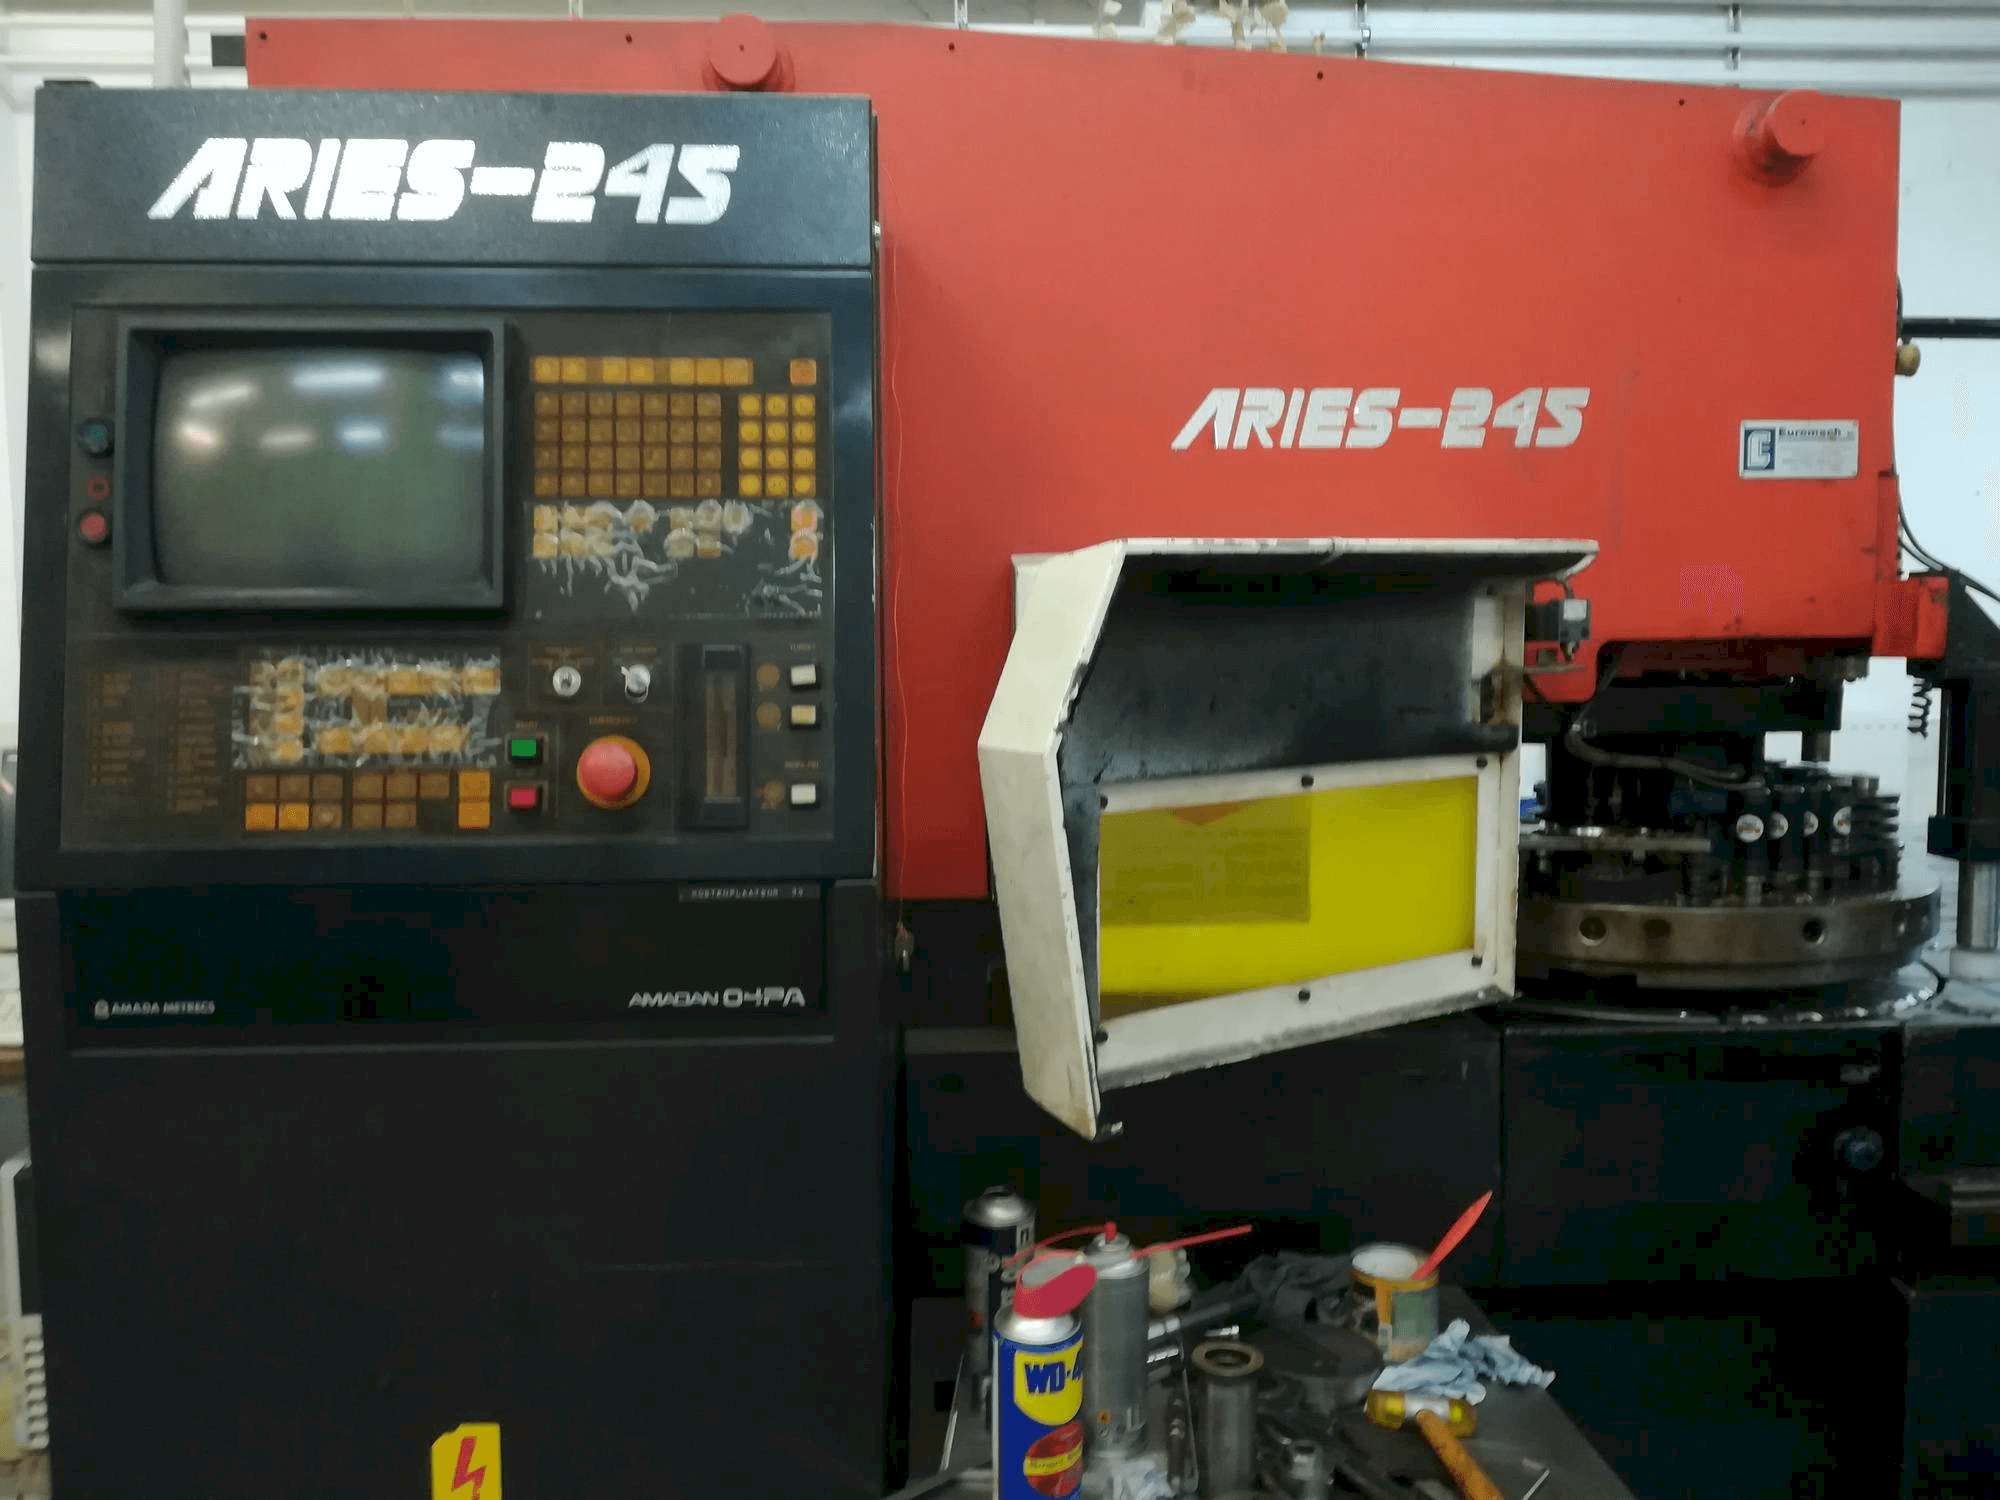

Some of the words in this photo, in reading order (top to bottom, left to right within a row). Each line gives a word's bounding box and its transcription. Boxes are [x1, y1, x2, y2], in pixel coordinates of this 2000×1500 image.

[147, 137, 741, 225] ARIES-245
[1169, 386, 1591, 450] ARIES-245
[111, 1000, 160, 1015] AMADA
